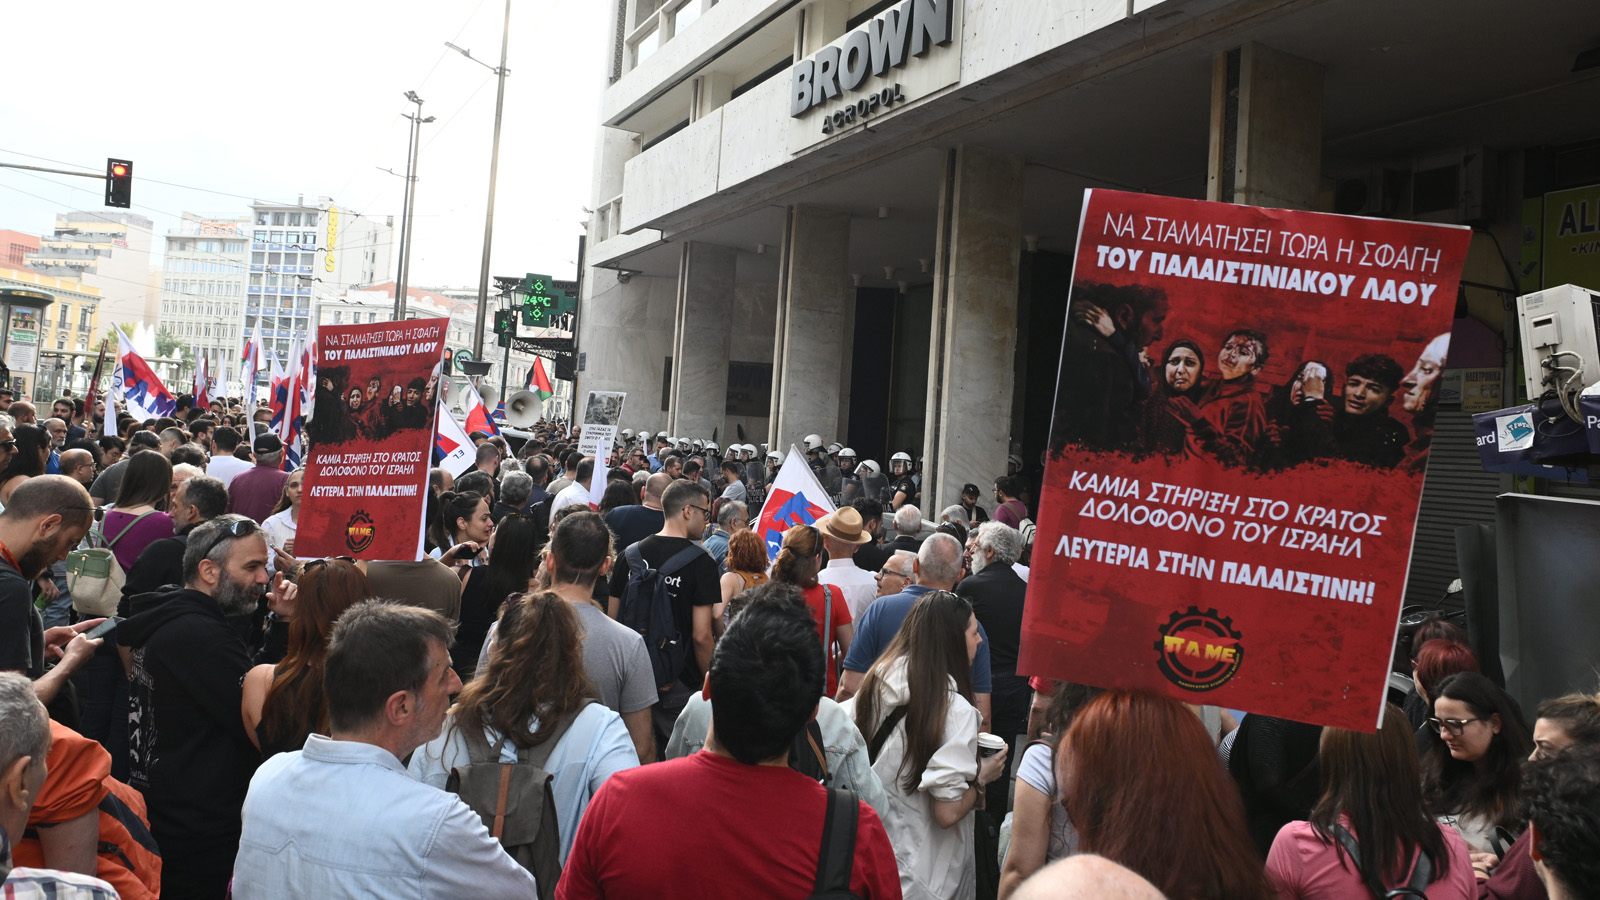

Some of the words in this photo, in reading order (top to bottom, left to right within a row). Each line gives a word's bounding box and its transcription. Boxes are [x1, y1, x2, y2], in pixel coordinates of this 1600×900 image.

[791, 0, 953, 118] BROWN
[822, 83, 905, 134] ACROPOL
[1103, 211, 1135, 239] ΝΑ
[1141, 216, 1272, 254] ΣΤΑΜΑΤΗΣΕΙ
[1280, 231, 1328, 261] ΤΩΡΑ
[1336, 238, 1354, 264] Η
[1358, 241, 1441, 274] ΣΦΑΓΗ
[1559, 200, 1600, 236] AL
[1097, 244, 1143, 271] ΤΟΥ
[1149, 251, 1356, 297] ΠΑΛΑΙΣΤΙΝΙΑΚΟΥ
[1360, 277, 1438, 306] ΛΑΟΥ
[324, 350, 342, 360] ΤΟΥ
[344, 344, 411, 360] ΠΑΛΑΙΣΤΙΝΙΑΚΟΥ
[412, 342, 438, 354] ΛΑΟΥ
[325, 335, 339, 346] ΝΑ
[341, 331, 384, 346] ΣΤΑΜΑΤΗΣΕΙ
[385, 329, 403, 342] ΤΩΡΑ
[405, 329, 412, 340] Η
[412, 326, 440, 340] ΣΦΑΓΗ
[316, 454, 341, 464] ΚΑΜΙΑ
[342, 453, 371, 464] ΣΤΗΡΙΞΗ
[372, 452, 390, 463] ΣΤΟ
[391, 451, 422, 462] ΚΡΑΤΟΣ
[320, 465, 367, 476] ΔΟΛΟΦΟΝΟ
[368, 464, 385, 476] ΤΟΥ
[386, 464, 414, 475] ΙΣΡΑΗΛ
[310, 485, 345, 496] ΛΕΥΤΕΡΙΑ
[346, 485, 364, 497] ΣΤΗΝ
[365, 484, 418, 497] ΠΑΛΑΙΣΤΙΝΗ!
[1068, 470, 1140, 500] ΚΑΜΙΑ
[1145, 482, 1240, 515] ΣΤΗΡΙΞΗ
[1242, 497, 1289, 521] ΣΤΟ
[1294, 504, 1387, 536] ΚΡΑΤΟΣ
[1078, 497, 1225, 538] ΔΟΛΟΦΟΝΟ
[1232, 521, 1278, 544] ΤΟΥ
[1280, 527, 1362, 559] ΙΣΡΑΗΛ
[1054, 534, 1150, 570] ΛΕΥΤΕΡΙΑ
[1155, 550, 1215, 581] ΣΤΗΝ
[1220, 561, 1375, 605] ΠΑΛΑΙΣΤΙΝΗ!
